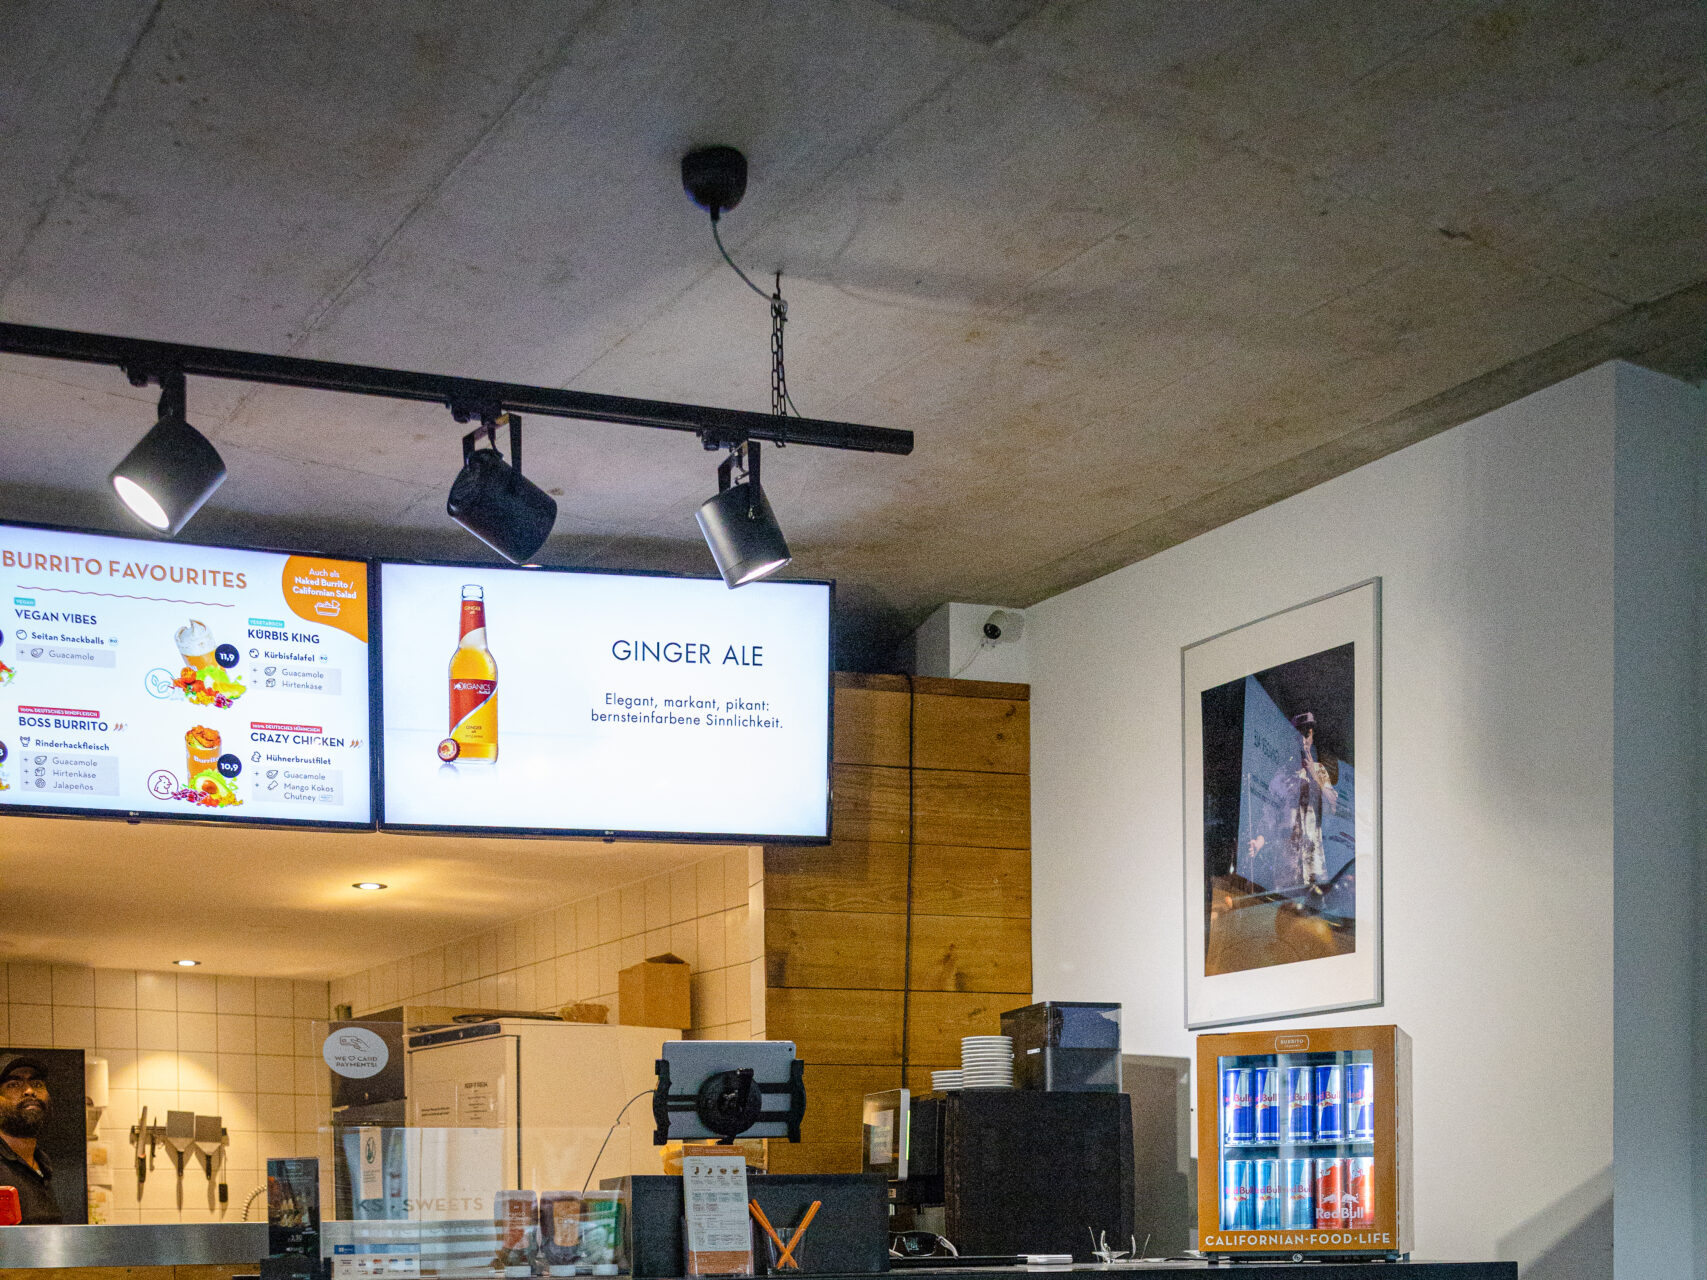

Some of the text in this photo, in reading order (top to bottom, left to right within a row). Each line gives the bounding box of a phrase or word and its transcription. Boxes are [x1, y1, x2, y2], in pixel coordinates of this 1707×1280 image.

[2, 550, 247, 589] BURRITO FAVOURITES
[309, 568, 340, 578] Auch als
[295, 576, 320, 586] Naked
[321, 579, 348, 589] Burrito
[292, 586, 357, 599] Californian Salad
[15, 609, 97, 625] VEGAN VIBES
[32, 632, 58, 642] Seitan
[61, 634, 104, 645] Snackballs
[248, 629, 320, 644] KÜRBIS KING
[49, 650, 94, 661] Guacamole
[265, 651, 315, 662] Kürbisfalafel
[612, 639, 763, 667] GINGER ALE
[282, 669, 324, 679] Guacamole
[605, 692, 770, 713] Elegant, markant, pikant:
[19, 717, 108, 732] BOSS BURRITO
[591, 708, 783, 729] bernsteinfarbene Sinnlichkeit.
[35, 739, 110, 751] Rinderhackfleisch
[250, 732, 345, 747] CRAZY CHICKEN
[52, 757, 98, 767] Guacamole
[266, 754, 331, 765] Hühnerbrustfilet
[220, 763, 239, 772] 10,9
[283, 770, 326, 780] Guacamole
[53, 780, 94, 792] Jalapeños
[283, 783, 334, 793] Mango Kokos
[283, 792, 316, 803] Chutney
[403, 1198, 484, 1212] SWEETS
[1316, 1207, 1340, 1219] Red
[1341, 1206, 1364, 1219] Bull
